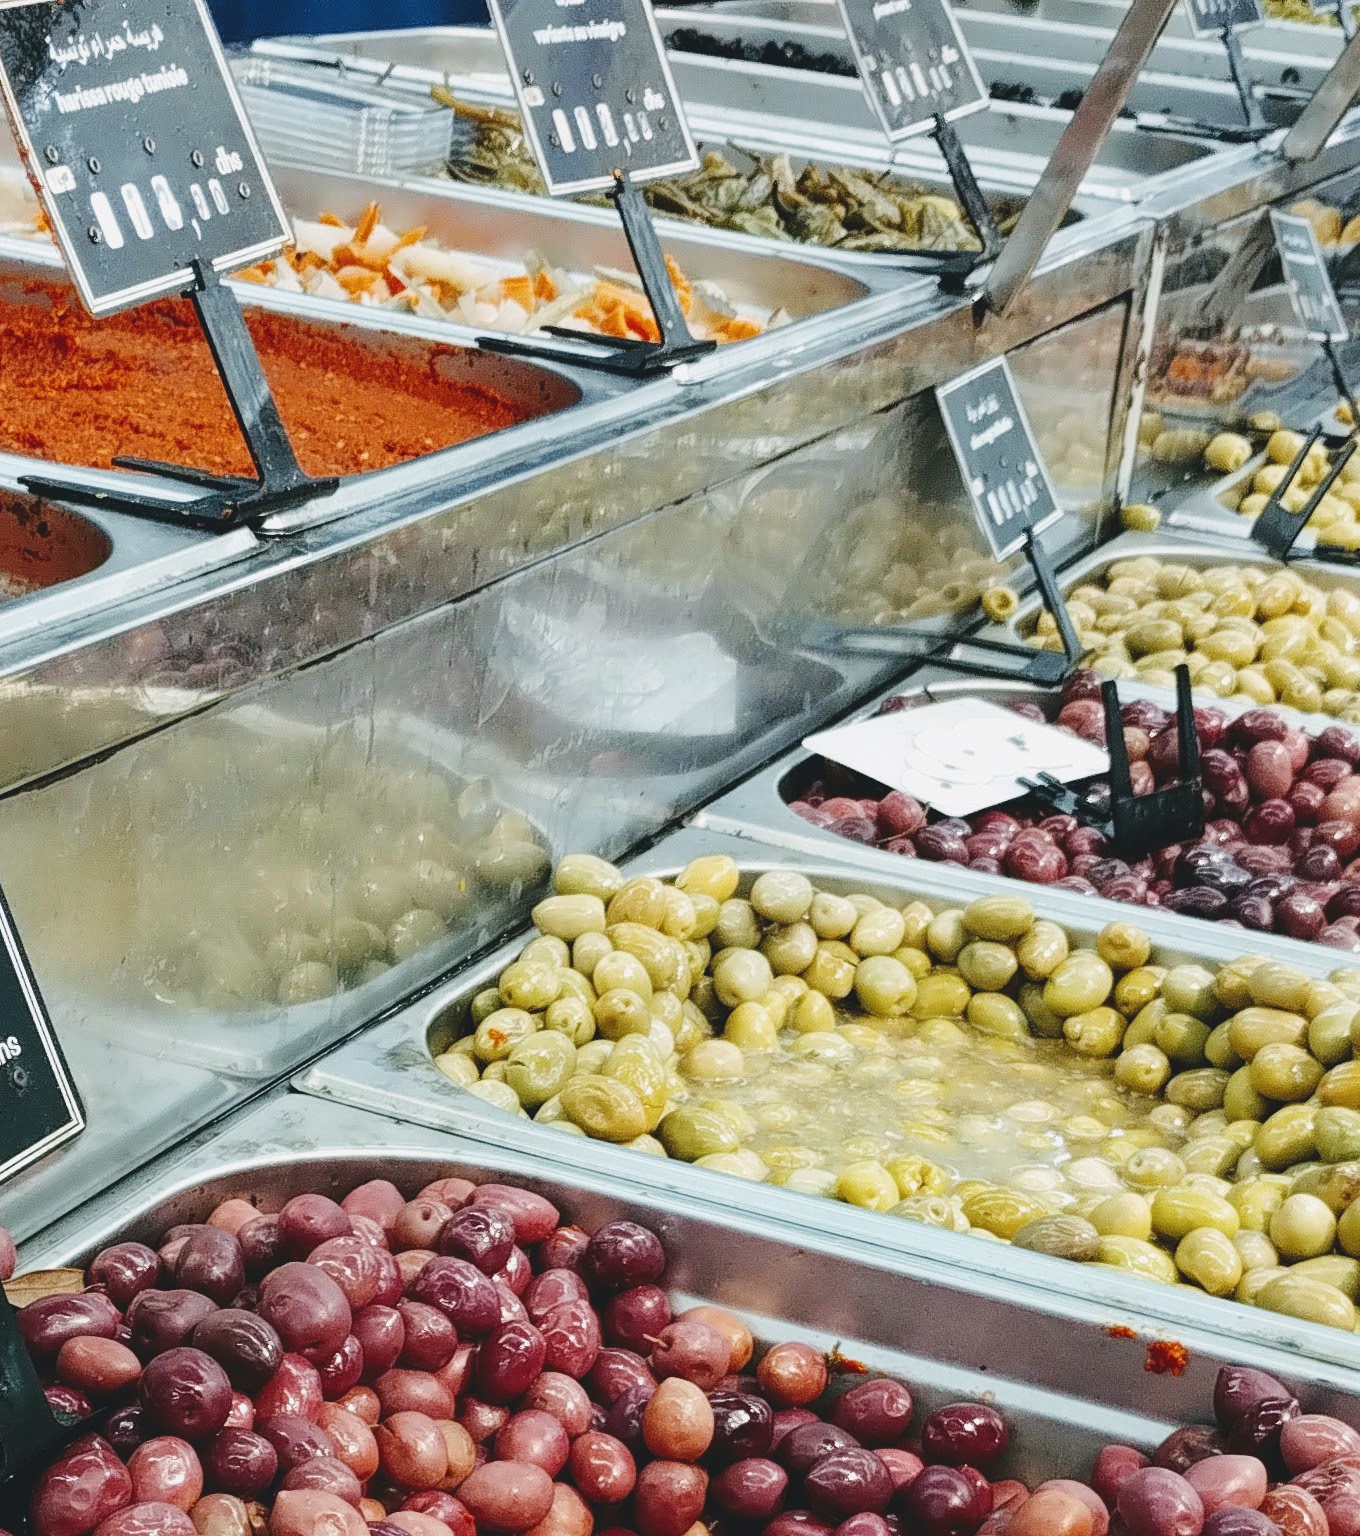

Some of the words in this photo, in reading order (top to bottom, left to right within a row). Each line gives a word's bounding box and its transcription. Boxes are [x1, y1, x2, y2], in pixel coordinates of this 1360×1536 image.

[53, 84, 108, 114] harissa
[103, 77, 145, 104] rouge
[140, 63, 189, 94] tunisie
[215, 145, 243, 176] dhs
